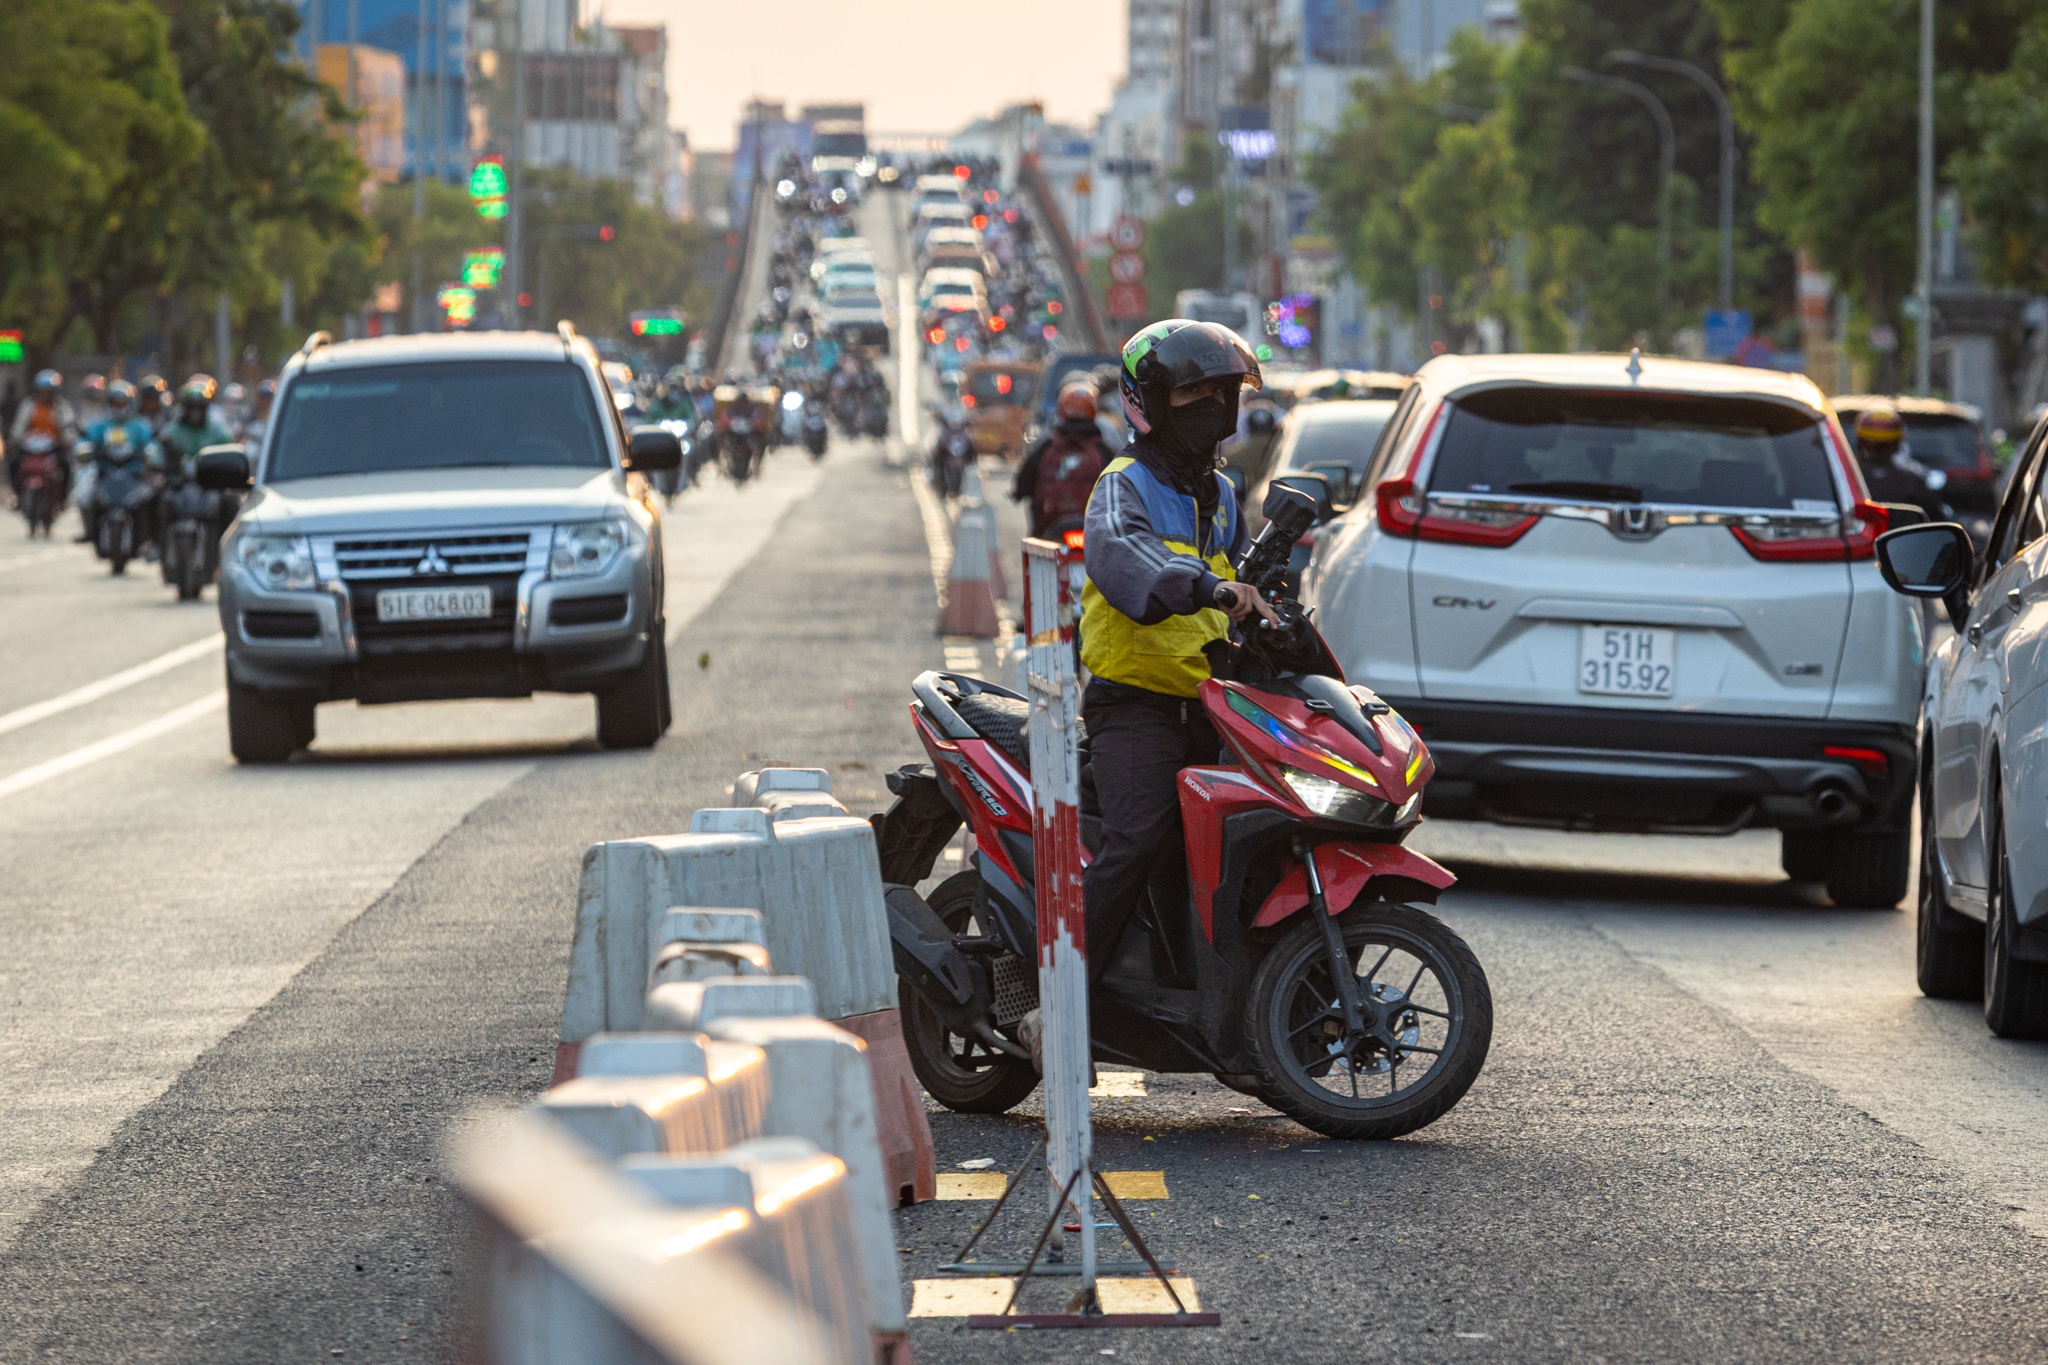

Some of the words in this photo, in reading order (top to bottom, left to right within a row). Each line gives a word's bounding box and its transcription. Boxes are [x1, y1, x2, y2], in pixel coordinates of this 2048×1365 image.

[1432, 595, 1497, 611] CR-V
[1603, 630, 1653, 660] 51H
[1584, 660, 1670, 692] 315.92
[1184, 776, 1210, 801] HONDA
